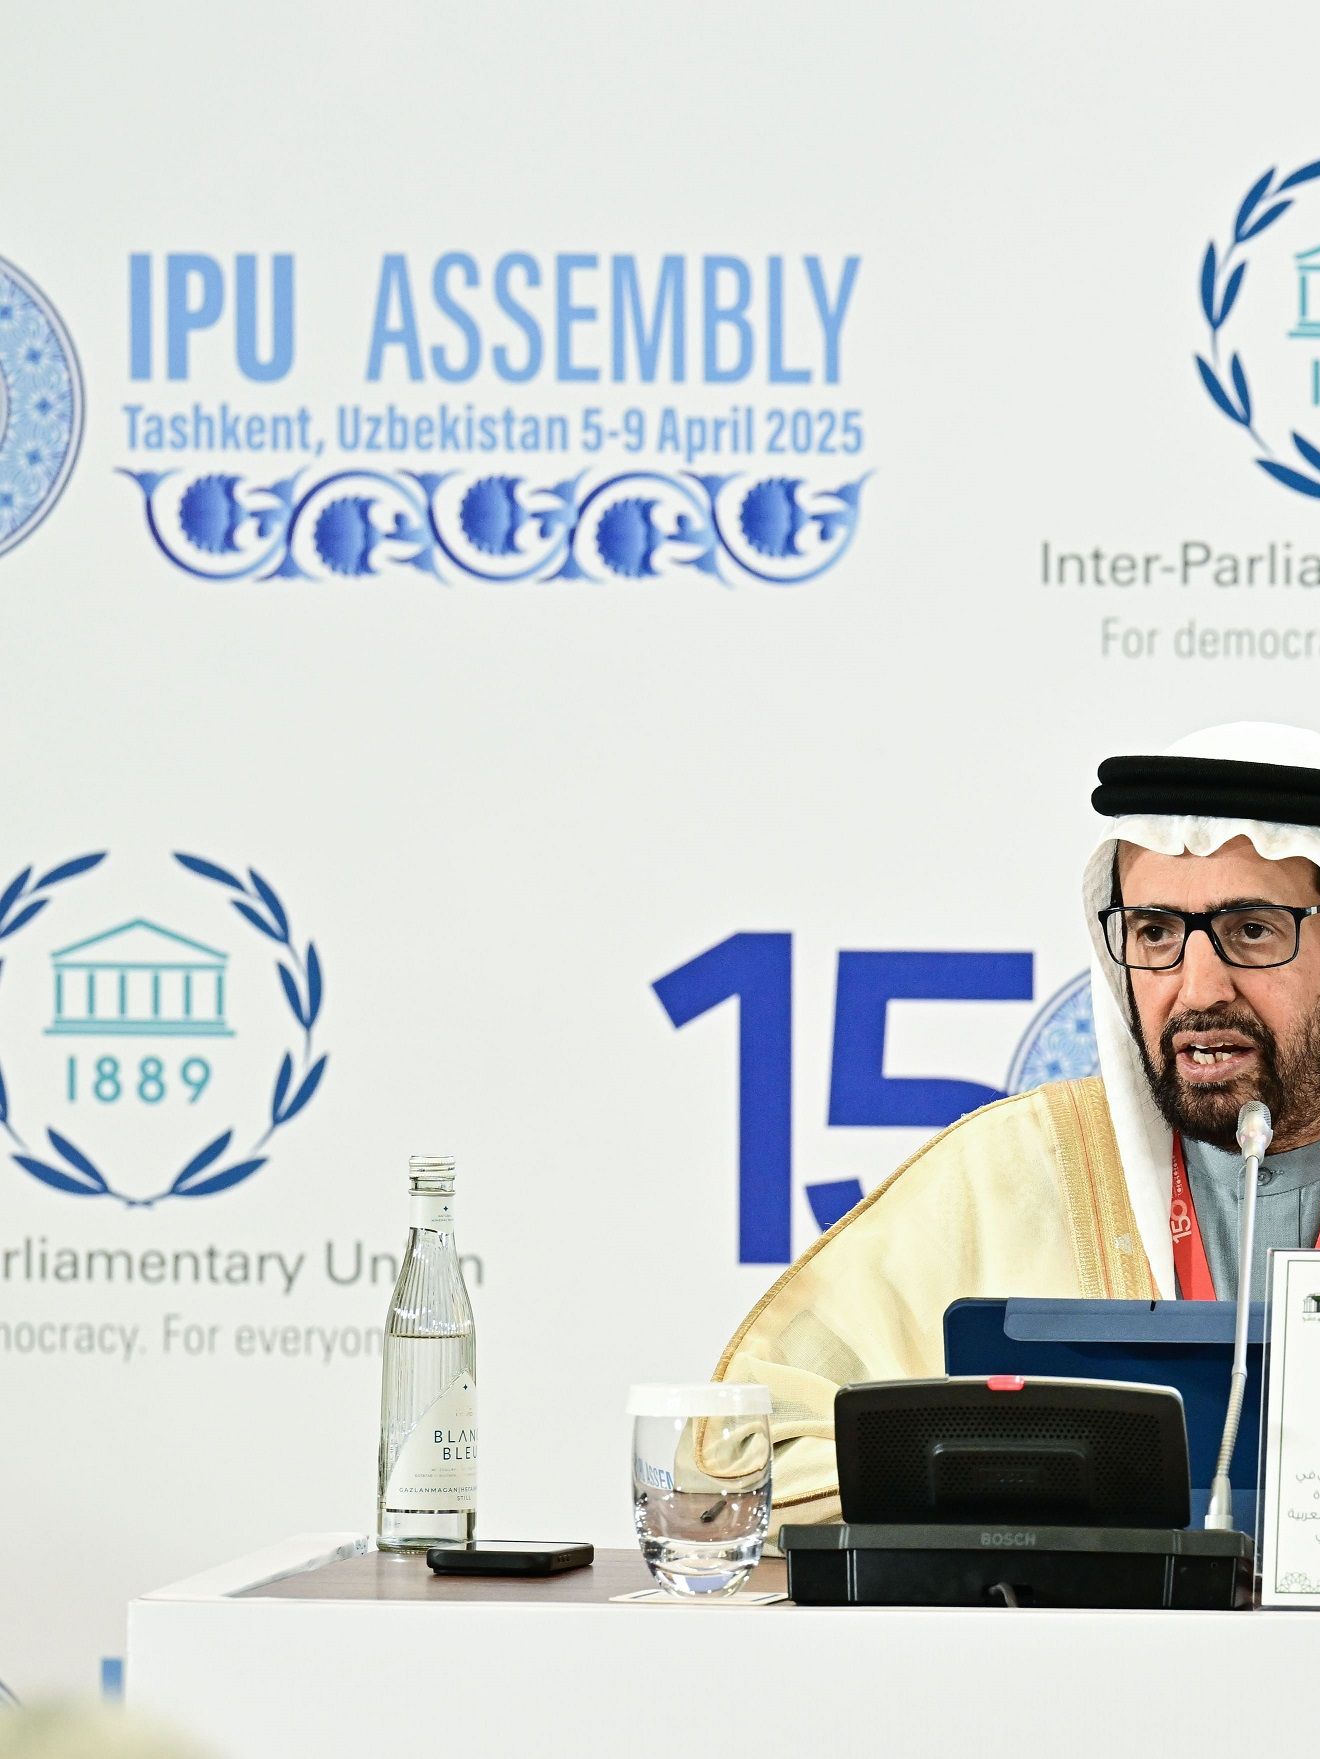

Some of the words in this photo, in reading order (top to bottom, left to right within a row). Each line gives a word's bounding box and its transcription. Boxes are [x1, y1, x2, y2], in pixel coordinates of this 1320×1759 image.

[128, 252, 296, 384] IPU
[364, 250, 862, 386] ASSEMBLY
[121, 402, 326, 458] Tashkent,
[337, 403, 570, 454] Uzbekistan
[581, 406, 646, 455] 5-9
[656, 405, 755, 465] April
[765, 408, 864, 456] 2025
[1101, 616, 1161, 660] For
[67, 1055, 212, 1105] 1889
[651, 930, 1098, 1265] 15
[1, 1236, 306, 1297] rliamentary
[162, 1312, 222, 1357] For
[234, 1324, 383, 1364] everyon
[434, 1429, 479, 1443] BLAN
[981, 1532, 1037, 1547] BOSCH
